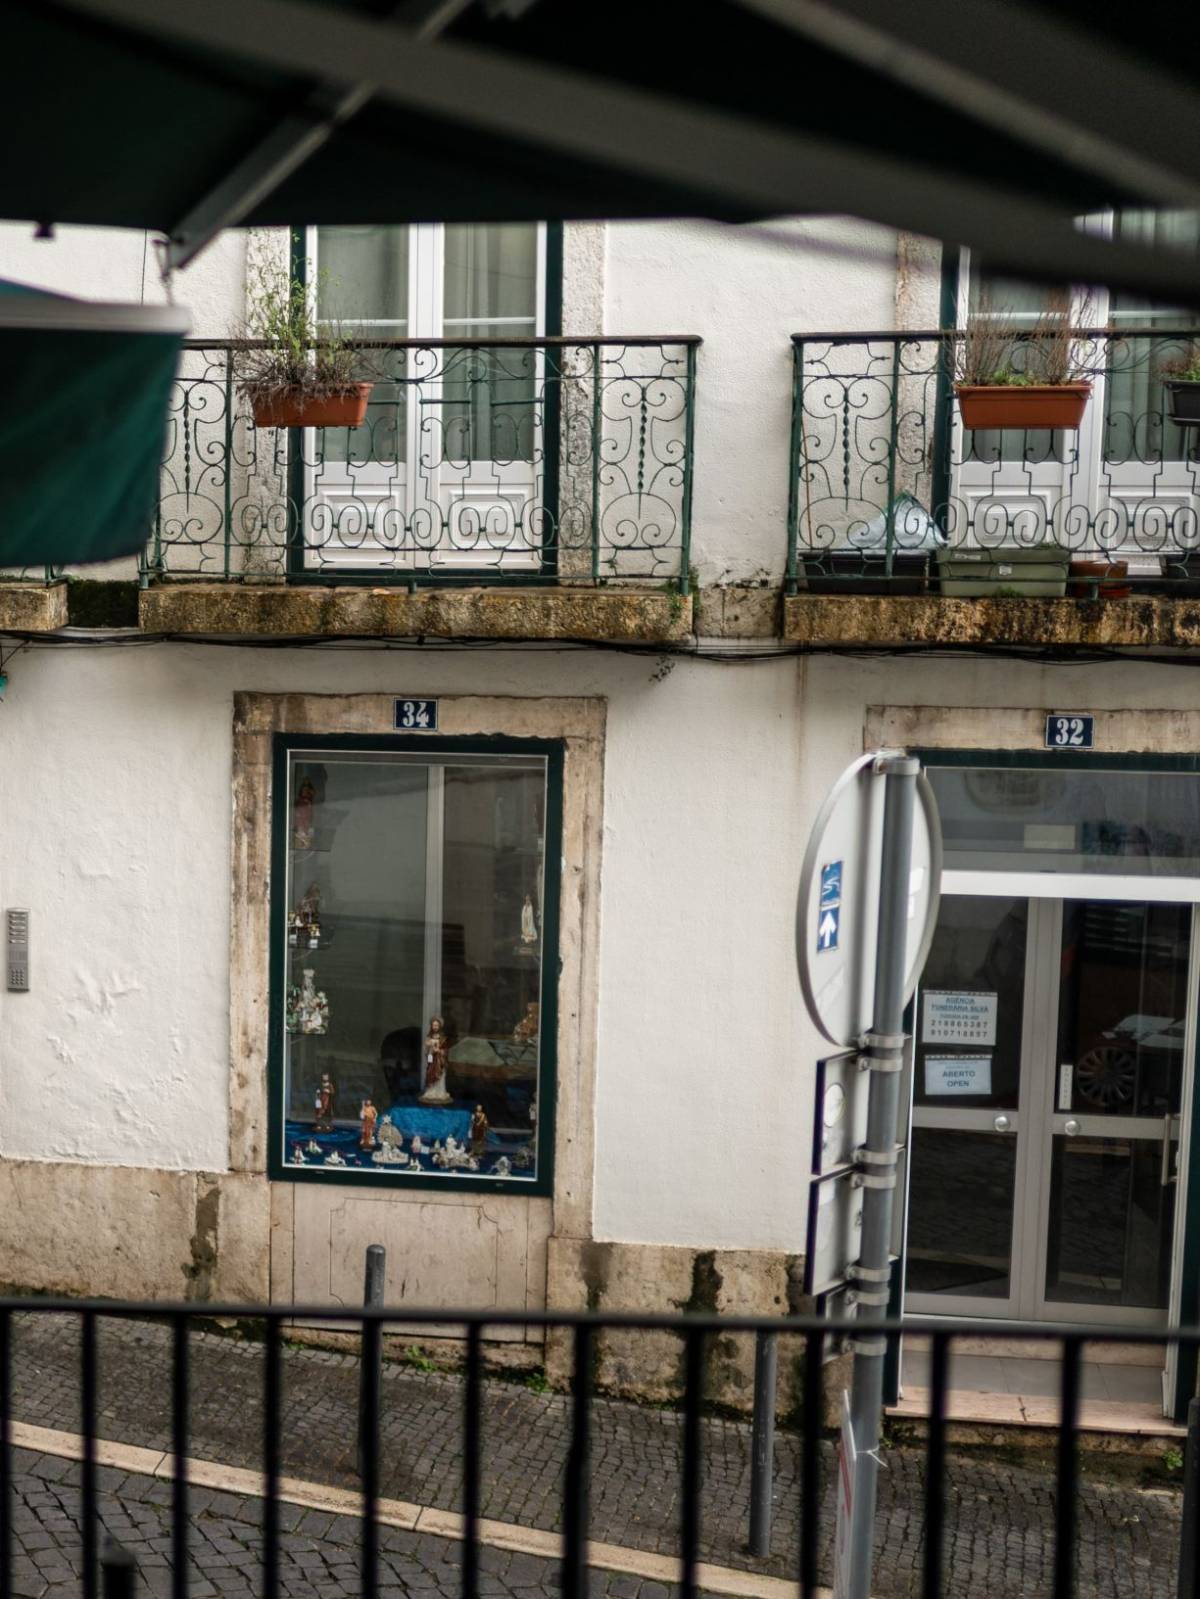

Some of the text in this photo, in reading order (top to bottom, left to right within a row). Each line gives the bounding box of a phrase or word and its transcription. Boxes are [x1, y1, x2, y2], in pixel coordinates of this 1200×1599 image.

[402, 702, 429, 728] 34
[1055, 718, 1084, 745] 32
[942, 1070, 976, 1078] ABERTO
[946, 1080, 970, 1088] OPEN
